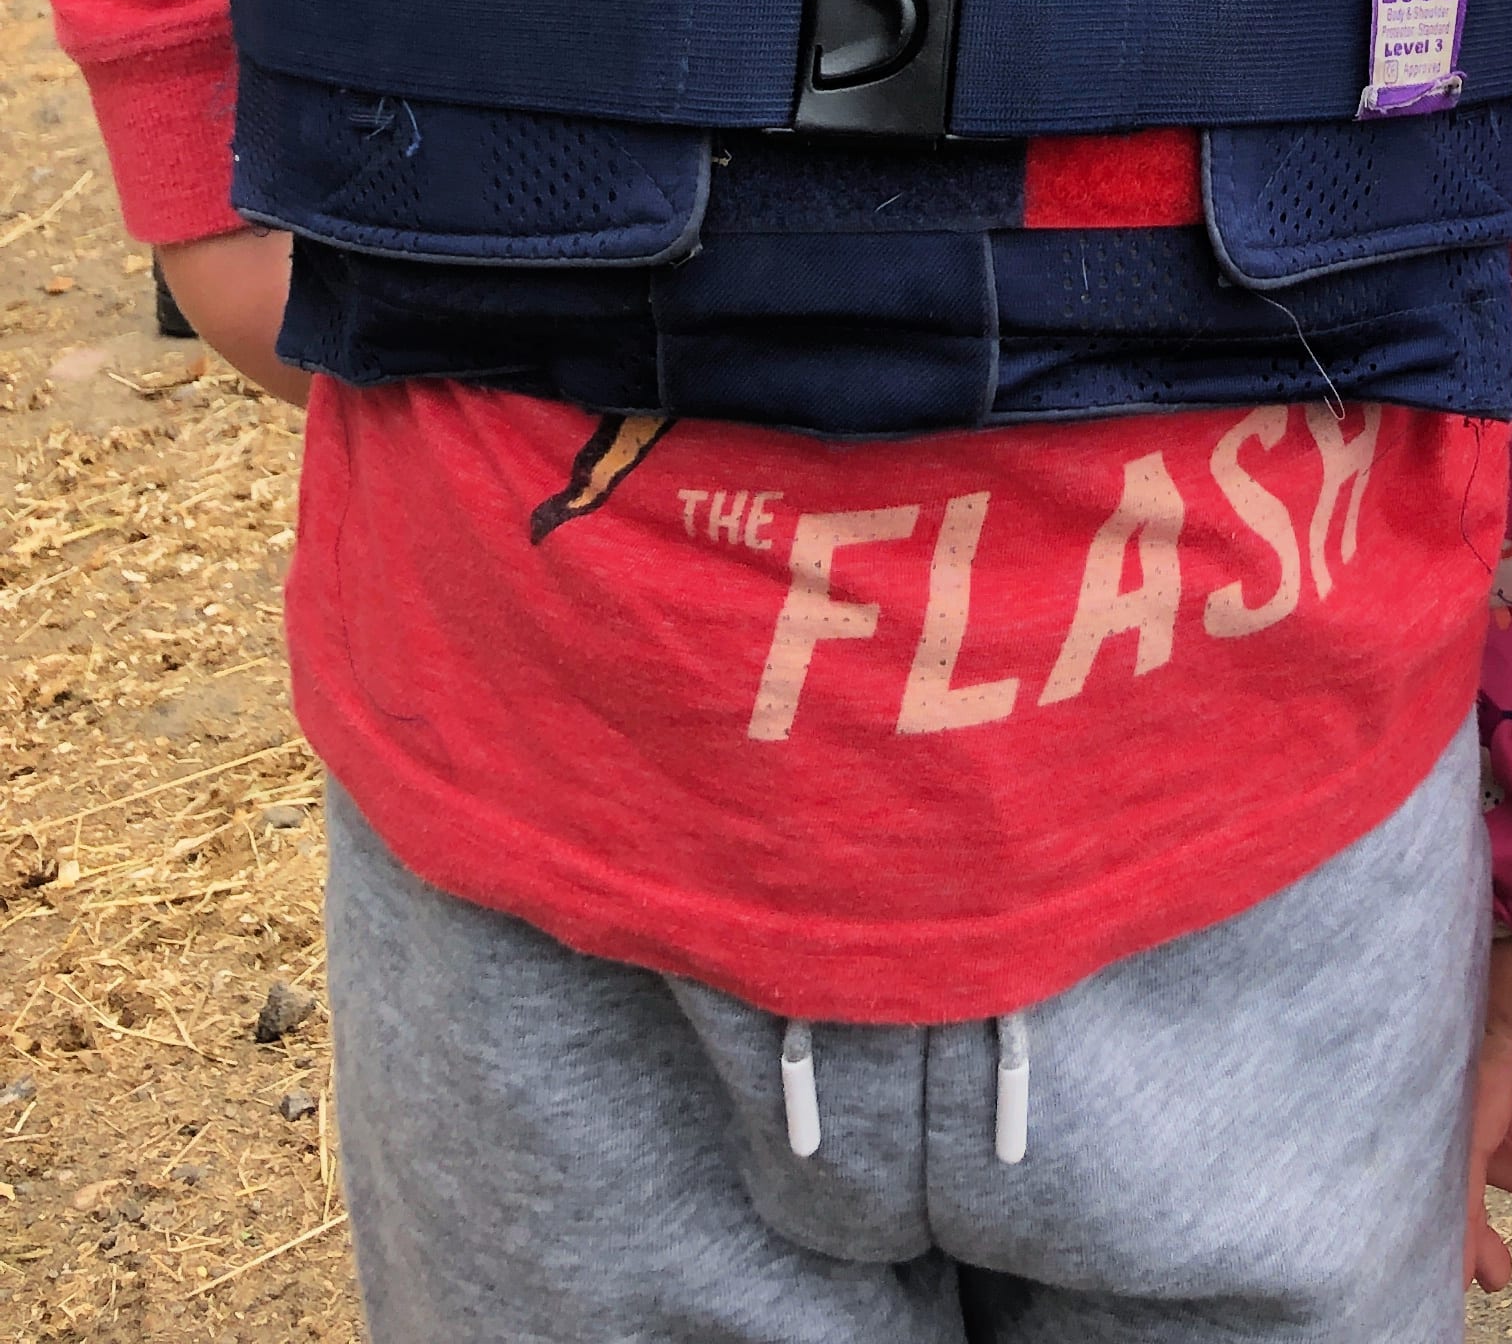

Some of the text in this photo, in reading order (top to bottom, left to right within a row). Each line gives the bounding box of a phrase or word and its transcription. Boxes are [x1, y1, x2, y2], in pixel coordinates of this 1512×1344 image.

[1385, 38, 1443, 57] Level 3
[678, 488, 784, 550] THE
[747, 402, 1382, 742] FLASH
